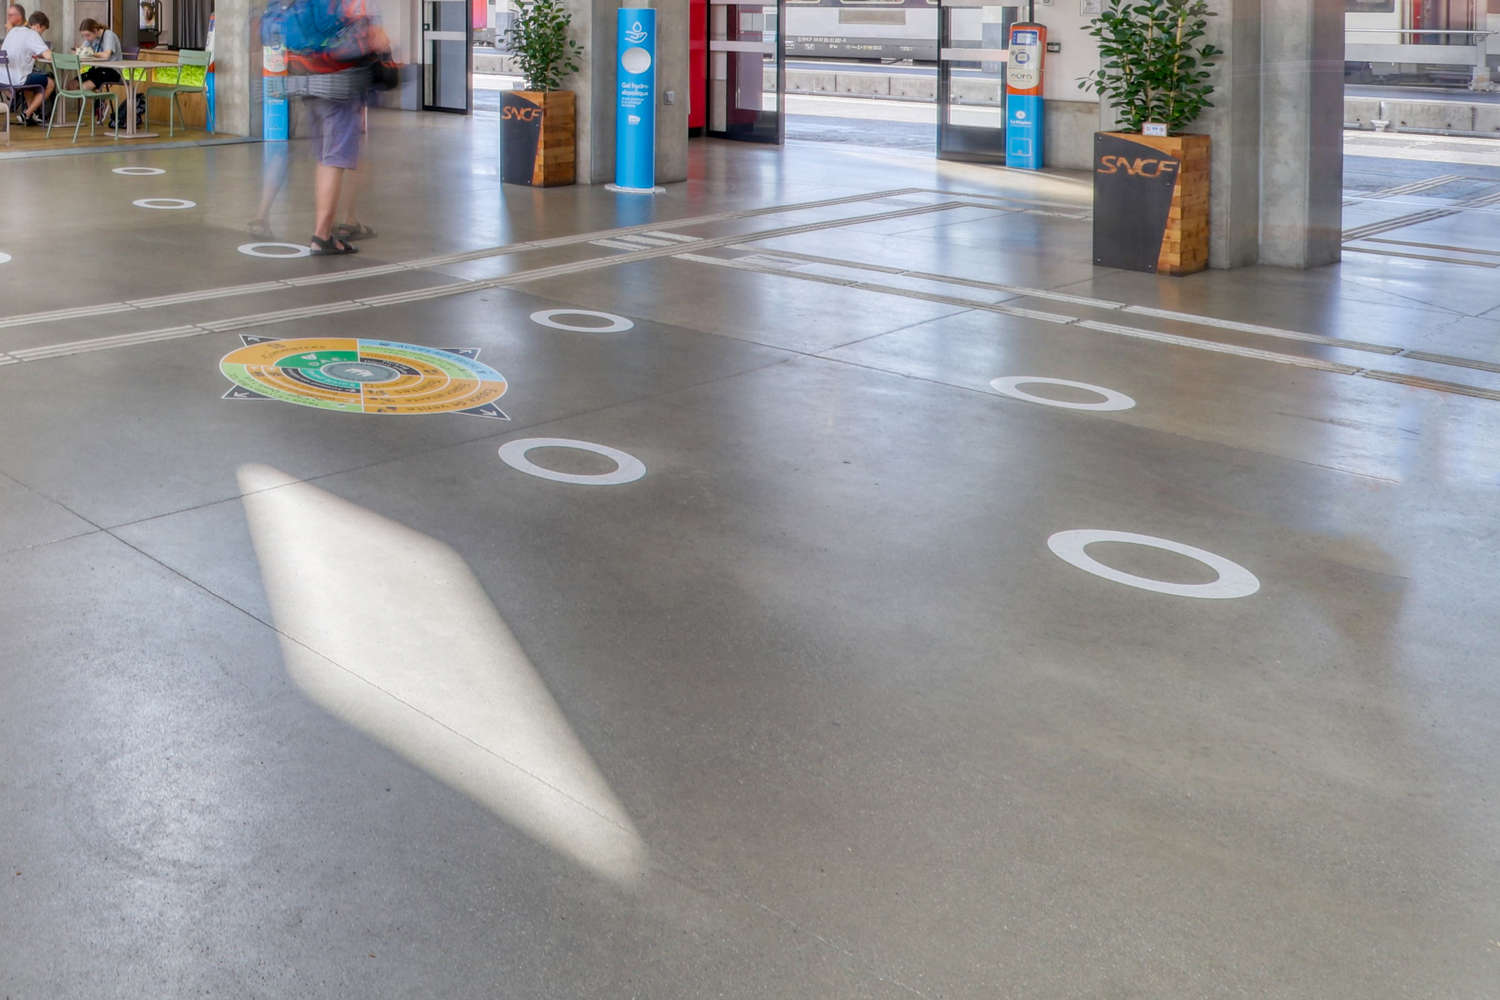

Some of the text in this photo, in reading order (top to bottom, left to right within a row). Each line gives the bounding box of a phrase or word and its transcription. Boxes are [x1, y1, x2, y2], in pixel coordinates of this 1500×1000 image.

[631, 82, 649, 91] hydro-
[621, 89, 649, 97] alcoolique
[502, 106, 541, 121] SNCF
[1097, 155, 1177, 177] SNCF
